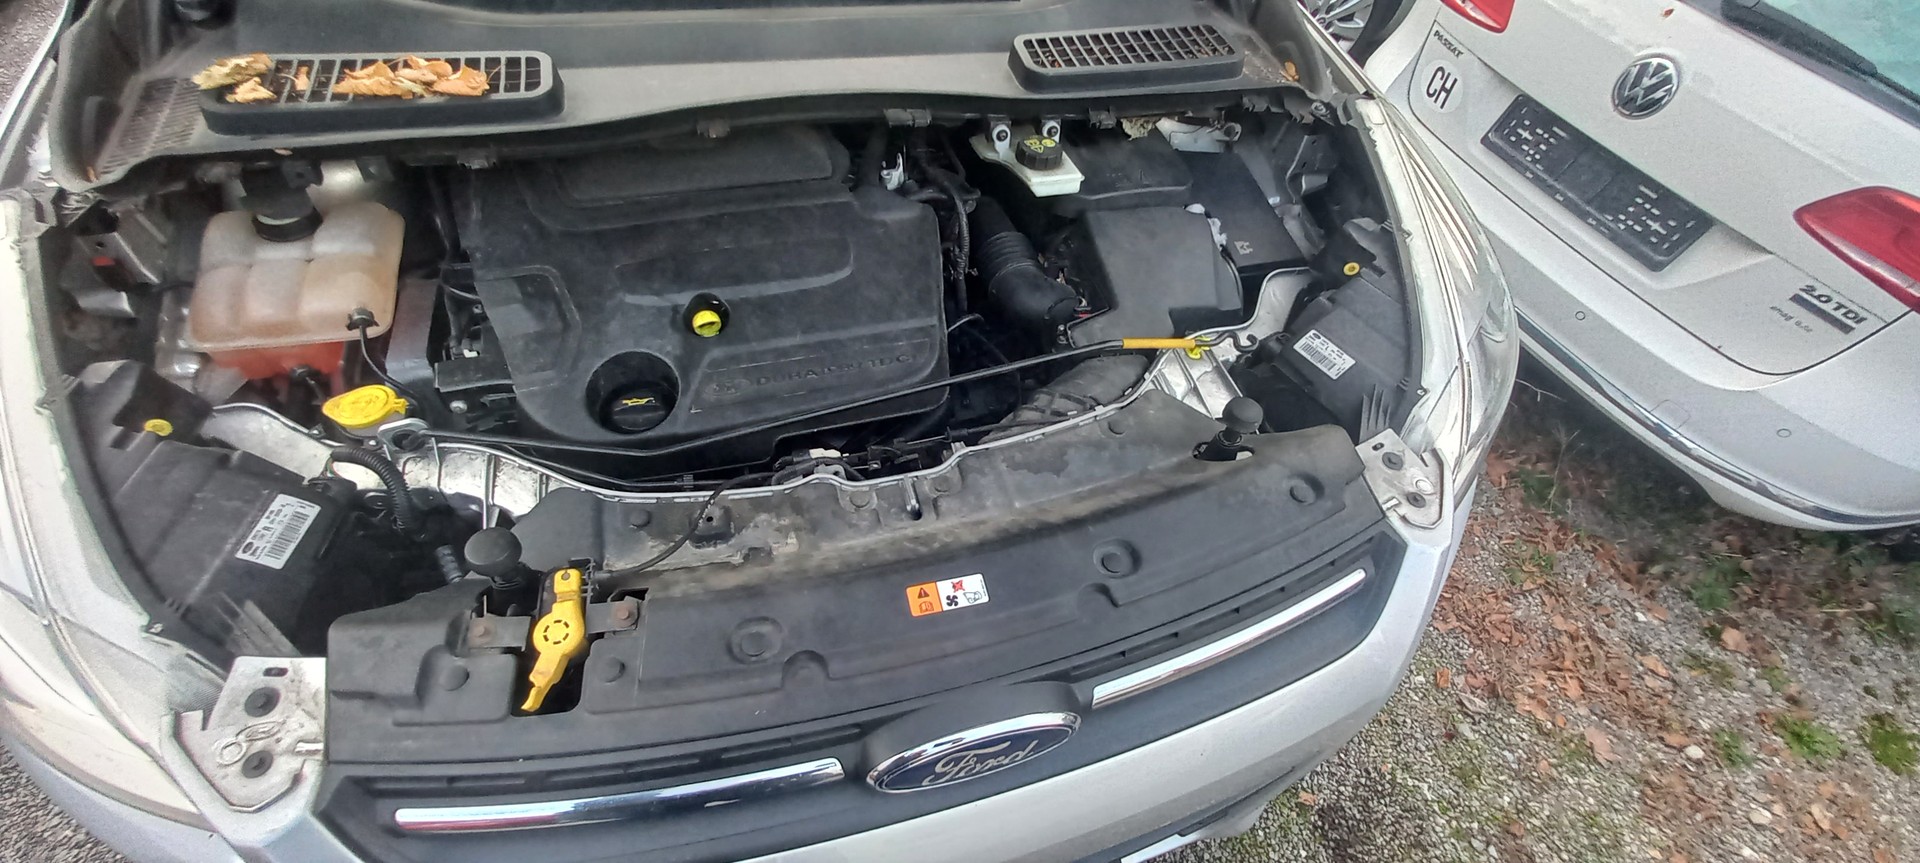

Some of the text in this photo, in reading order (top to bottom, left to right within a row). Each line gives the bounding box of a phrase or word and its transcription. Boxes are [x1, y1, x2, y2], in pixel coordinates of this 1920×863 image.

[1433, 30, 1464, 59] PASSAT
[1426, 66, 1458, 110] CH
[1832, 301, 1868, 325] TDI
[921, 740, 1039, 786] Ford
